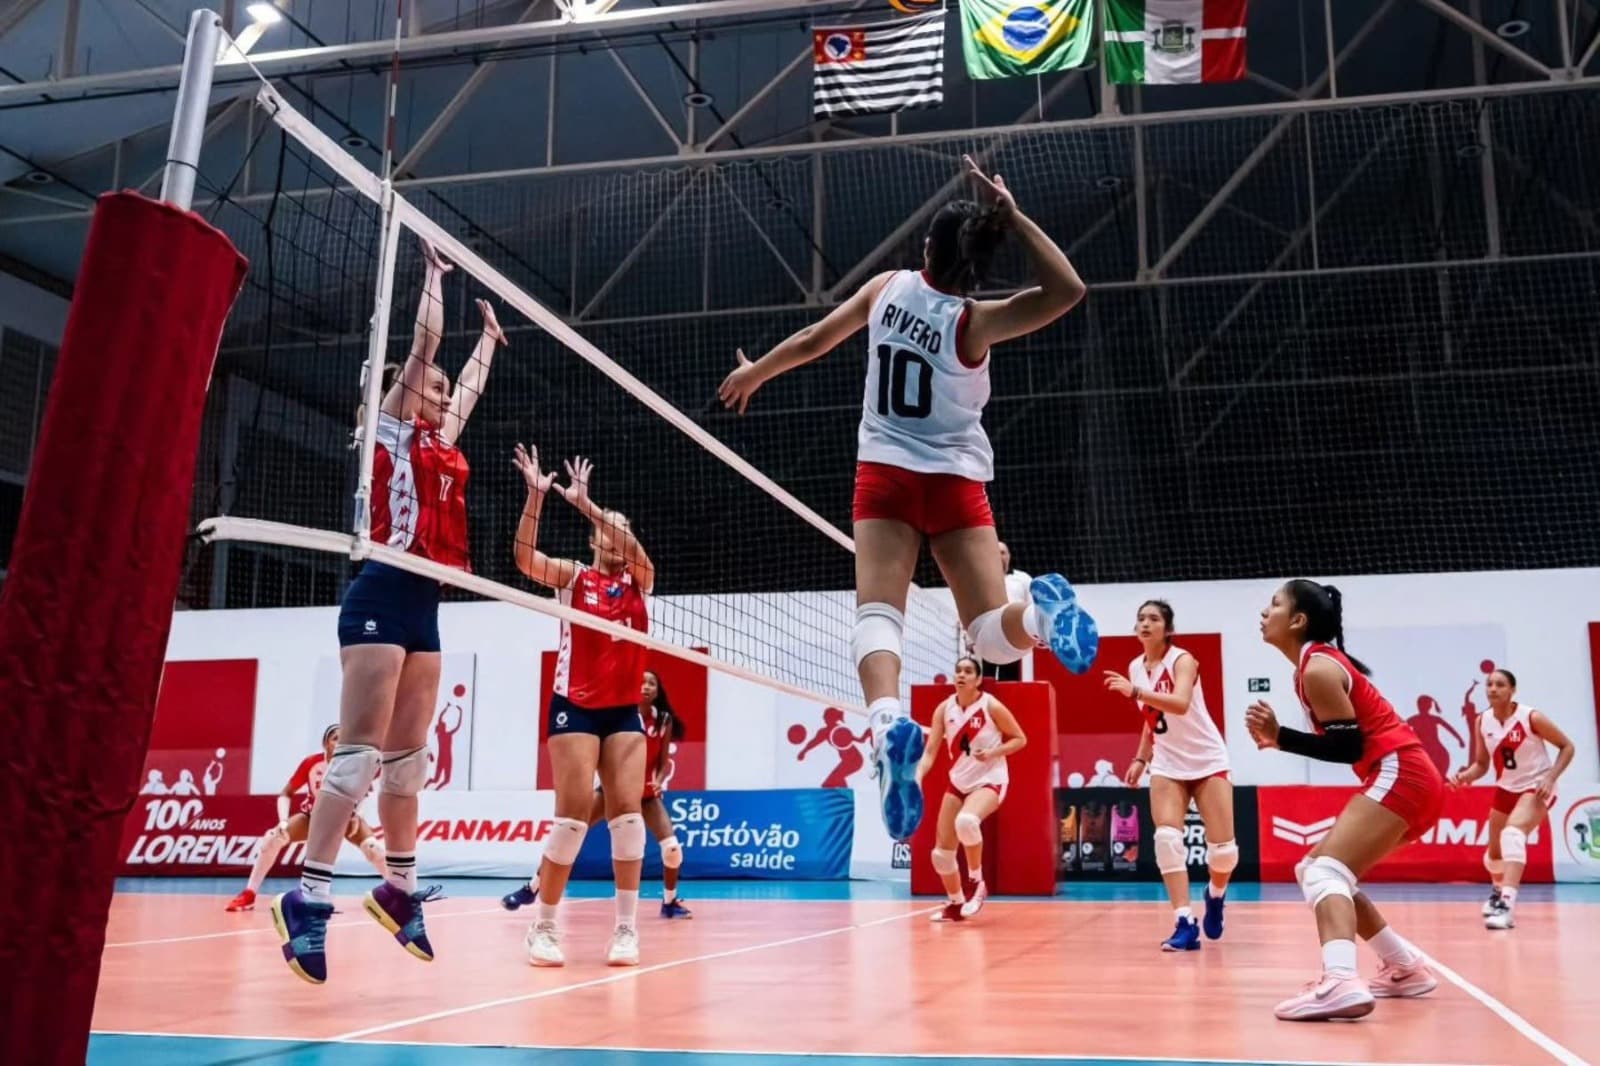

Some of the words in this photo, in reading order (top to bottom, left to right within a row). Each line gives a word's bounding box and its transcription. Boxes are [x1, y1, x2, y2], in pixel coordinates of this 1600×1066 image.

[881, 303, 942, 354] RIVERO
[877, 344, 933, 419] 10
[439, 473, 454, 502] 17
[1502, 747, 1517, 770] 8
[145, 799, 204, 830] 100
[190, 818, 227, 830] ANOS
[671, 798, 720, 822] São
[671, 820, 800, 848] Cristóvão
[730, 847, 796, 871] saúde
